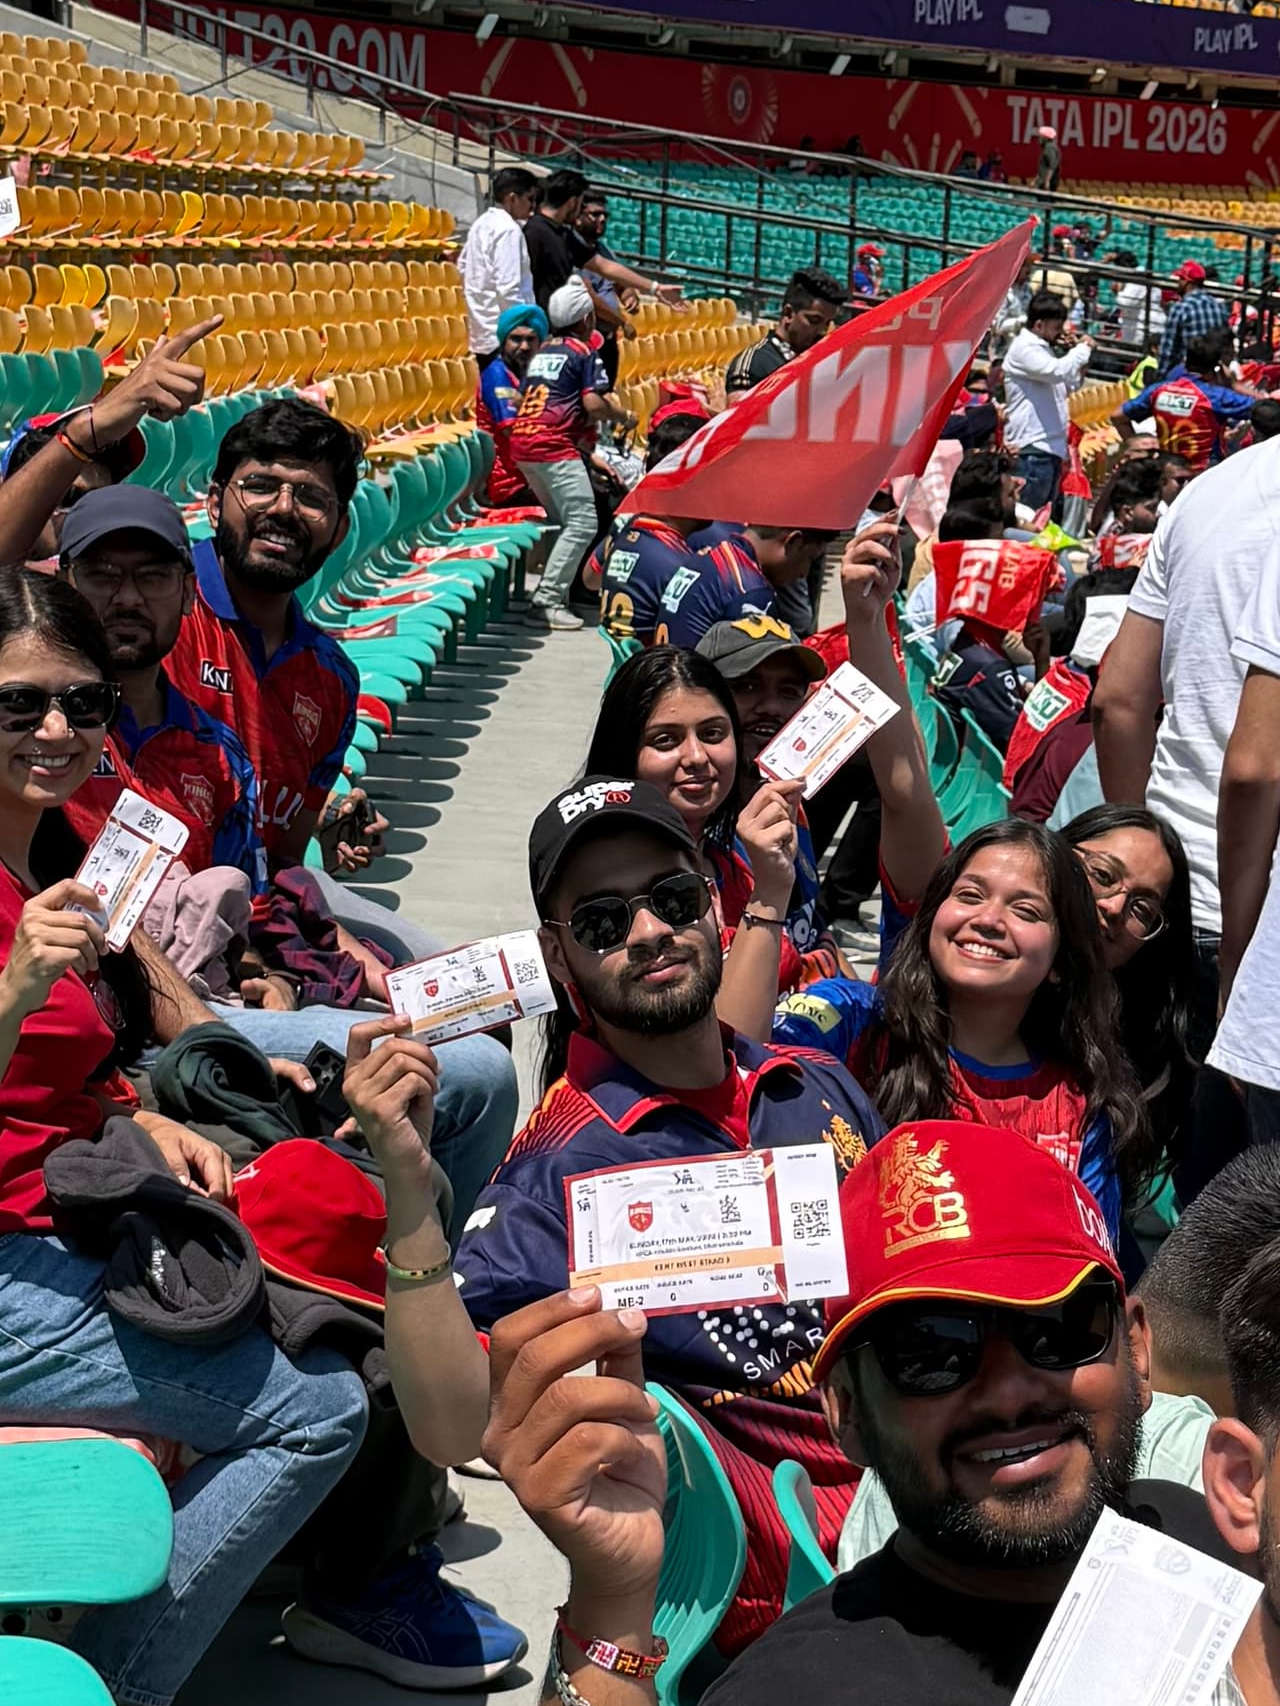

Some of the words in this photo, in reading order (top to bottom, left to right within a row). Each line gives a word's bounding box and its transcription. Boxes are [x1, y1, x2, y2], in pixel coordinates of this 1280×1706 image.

[1194, 26, 1232, 53] PLAY
[1233, 23, 1259, 51] IPL
[1007, 96, 1085, 148] TATA
[1092, 101, 1140, 150] IPL
[1145, 106, 1228, 155] 2026
[559, 793, 606, 824] Dry
[882, 1191, 969, 1244] RCB
